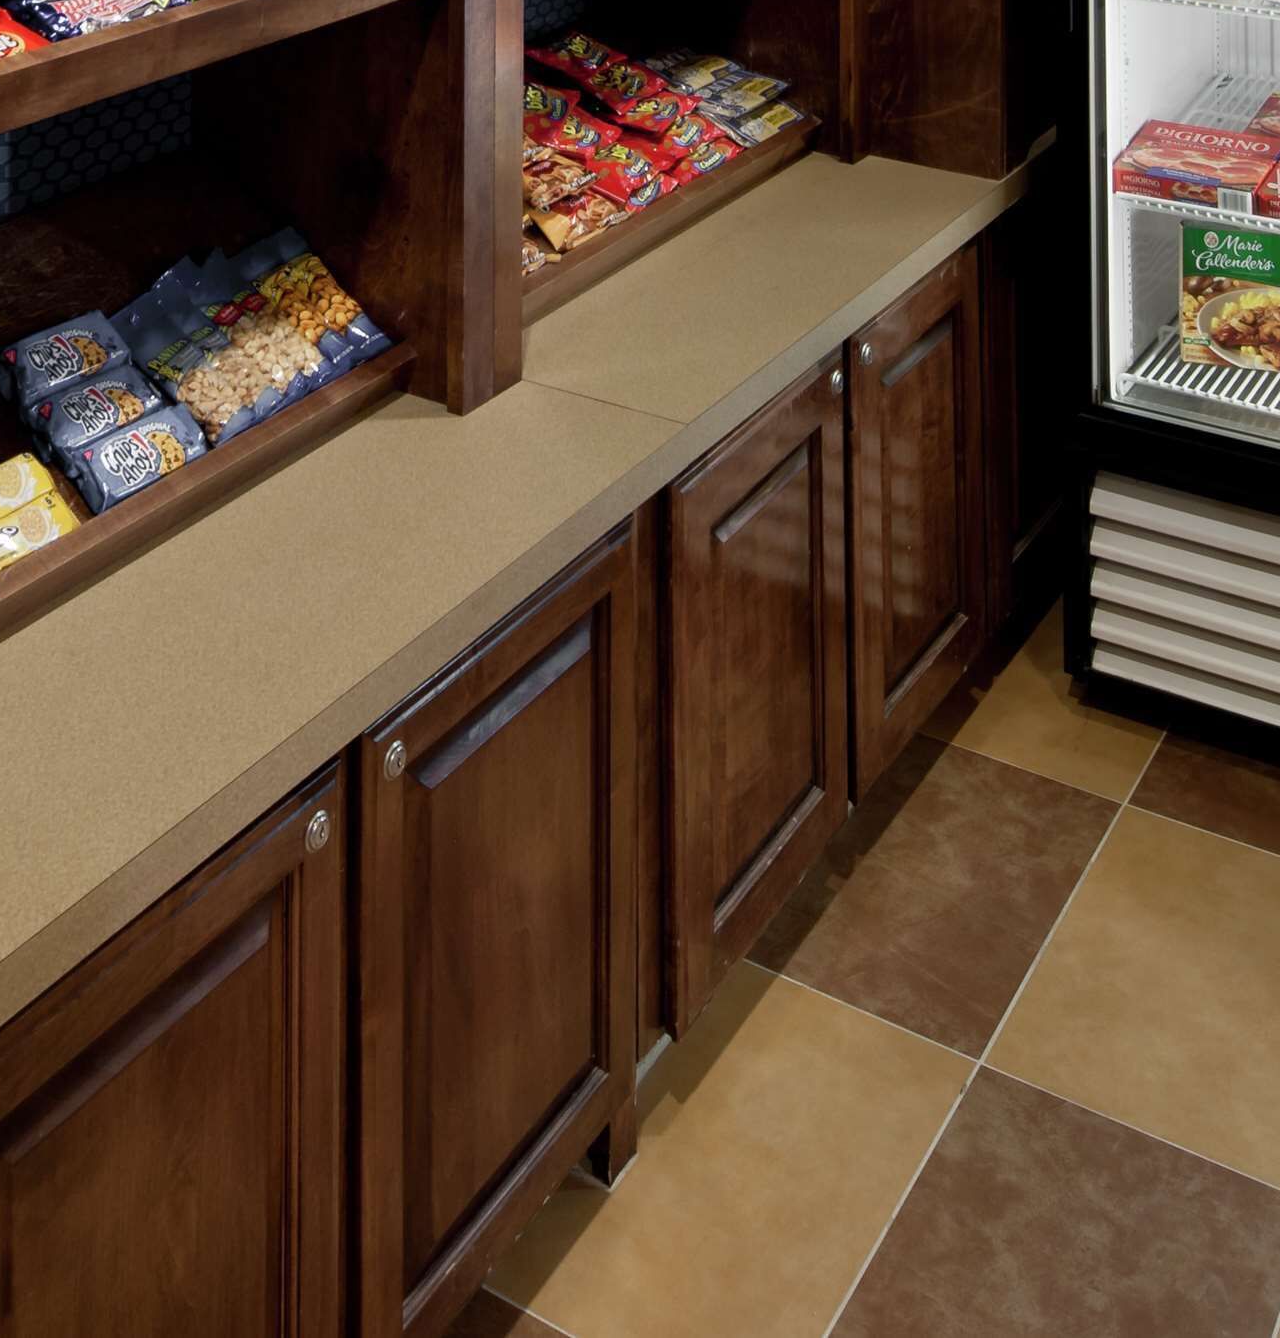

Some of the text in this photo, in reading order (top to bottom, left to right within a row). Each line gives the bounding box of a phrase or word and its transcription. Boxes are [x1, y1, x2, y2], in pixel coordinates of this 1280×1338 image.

[1192, 249, 1275, 270] Callender's
[1214, 235, 1263, 256] Marie
[28, 341, 62, 370] Chips
[63, 394, 98, 423] Chips
[104, 438, 140, 475] Chips
